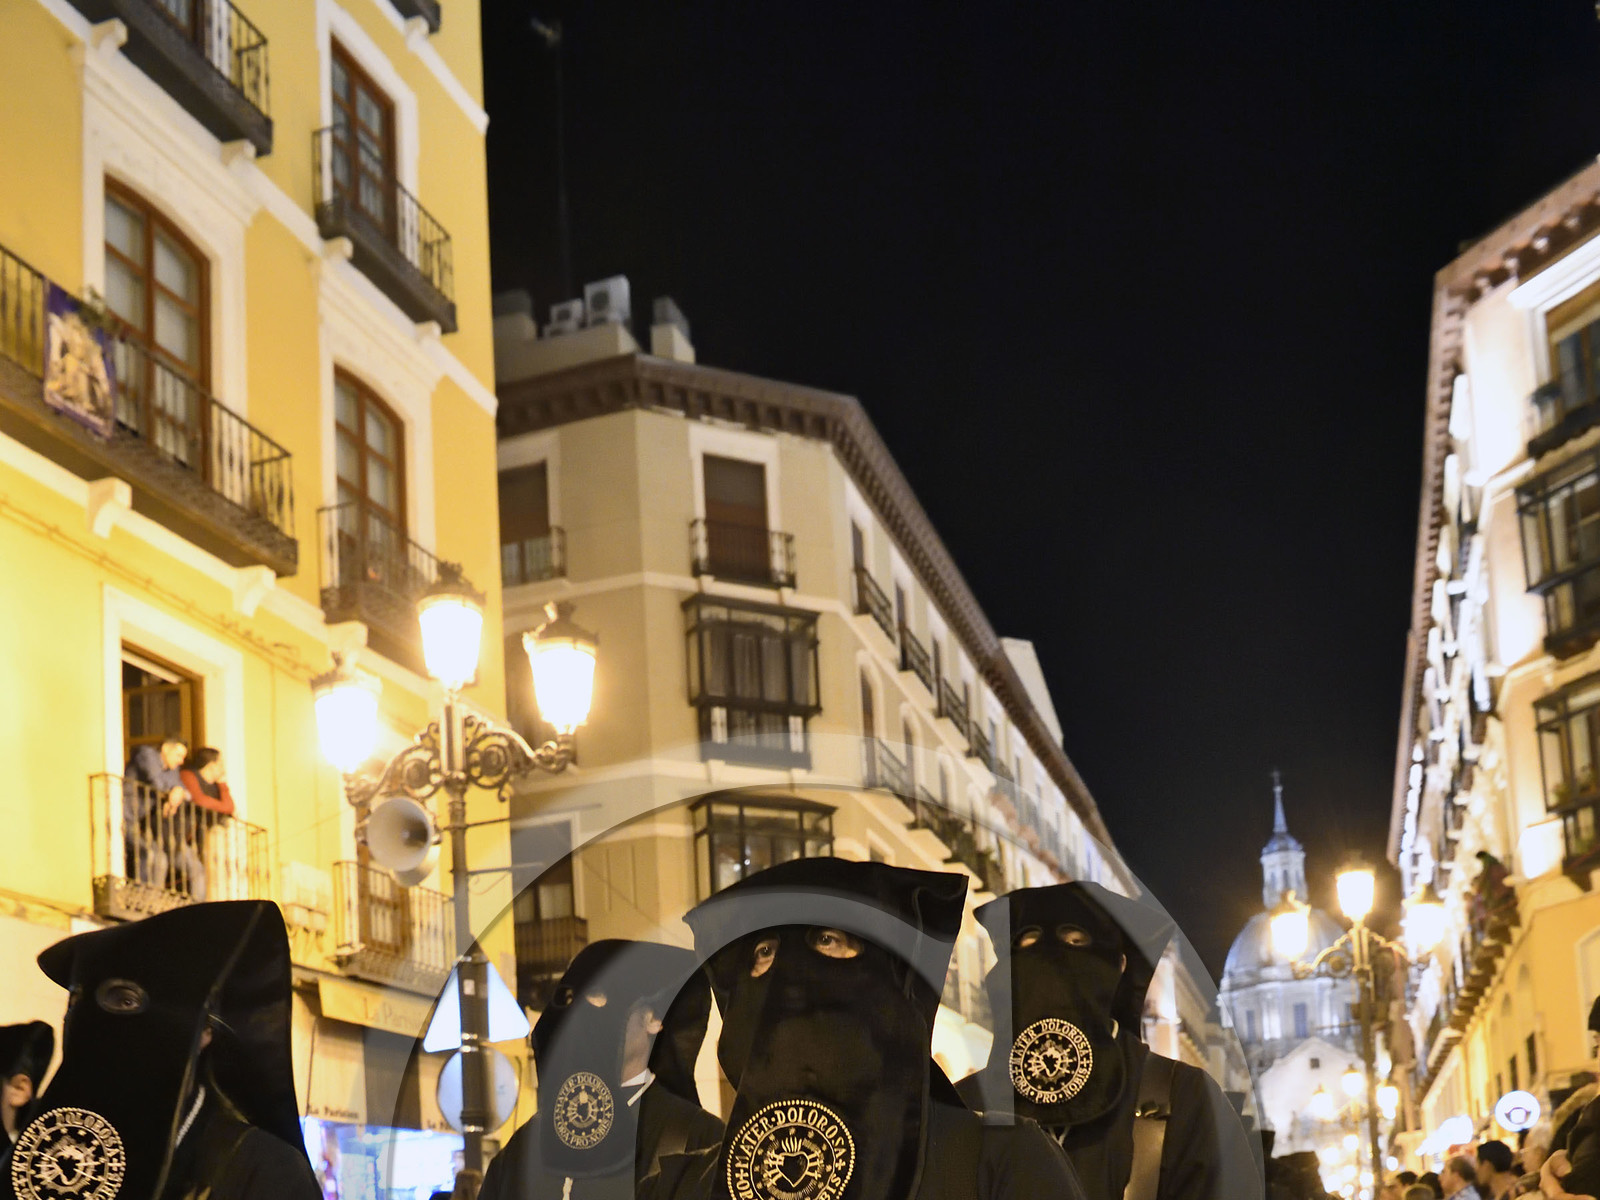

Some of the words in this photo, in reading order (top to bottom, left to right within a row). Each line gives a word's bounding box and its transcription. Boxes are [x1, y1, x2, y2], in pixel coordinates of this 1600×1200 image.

[1011, 1029, 1037, 1065] MATER
[1040, 1021, 1090, 1057] DOLOROSA
[1014, 1075, 1031, 1096] ORA
[1035, 1092, 1058, 1104] PRO
[1062, 1067, 1088, 1098] NOBIS
[735, 1116, 774, 1170] MATER
[774, 1106, 847, 1159] DOLOROSA
